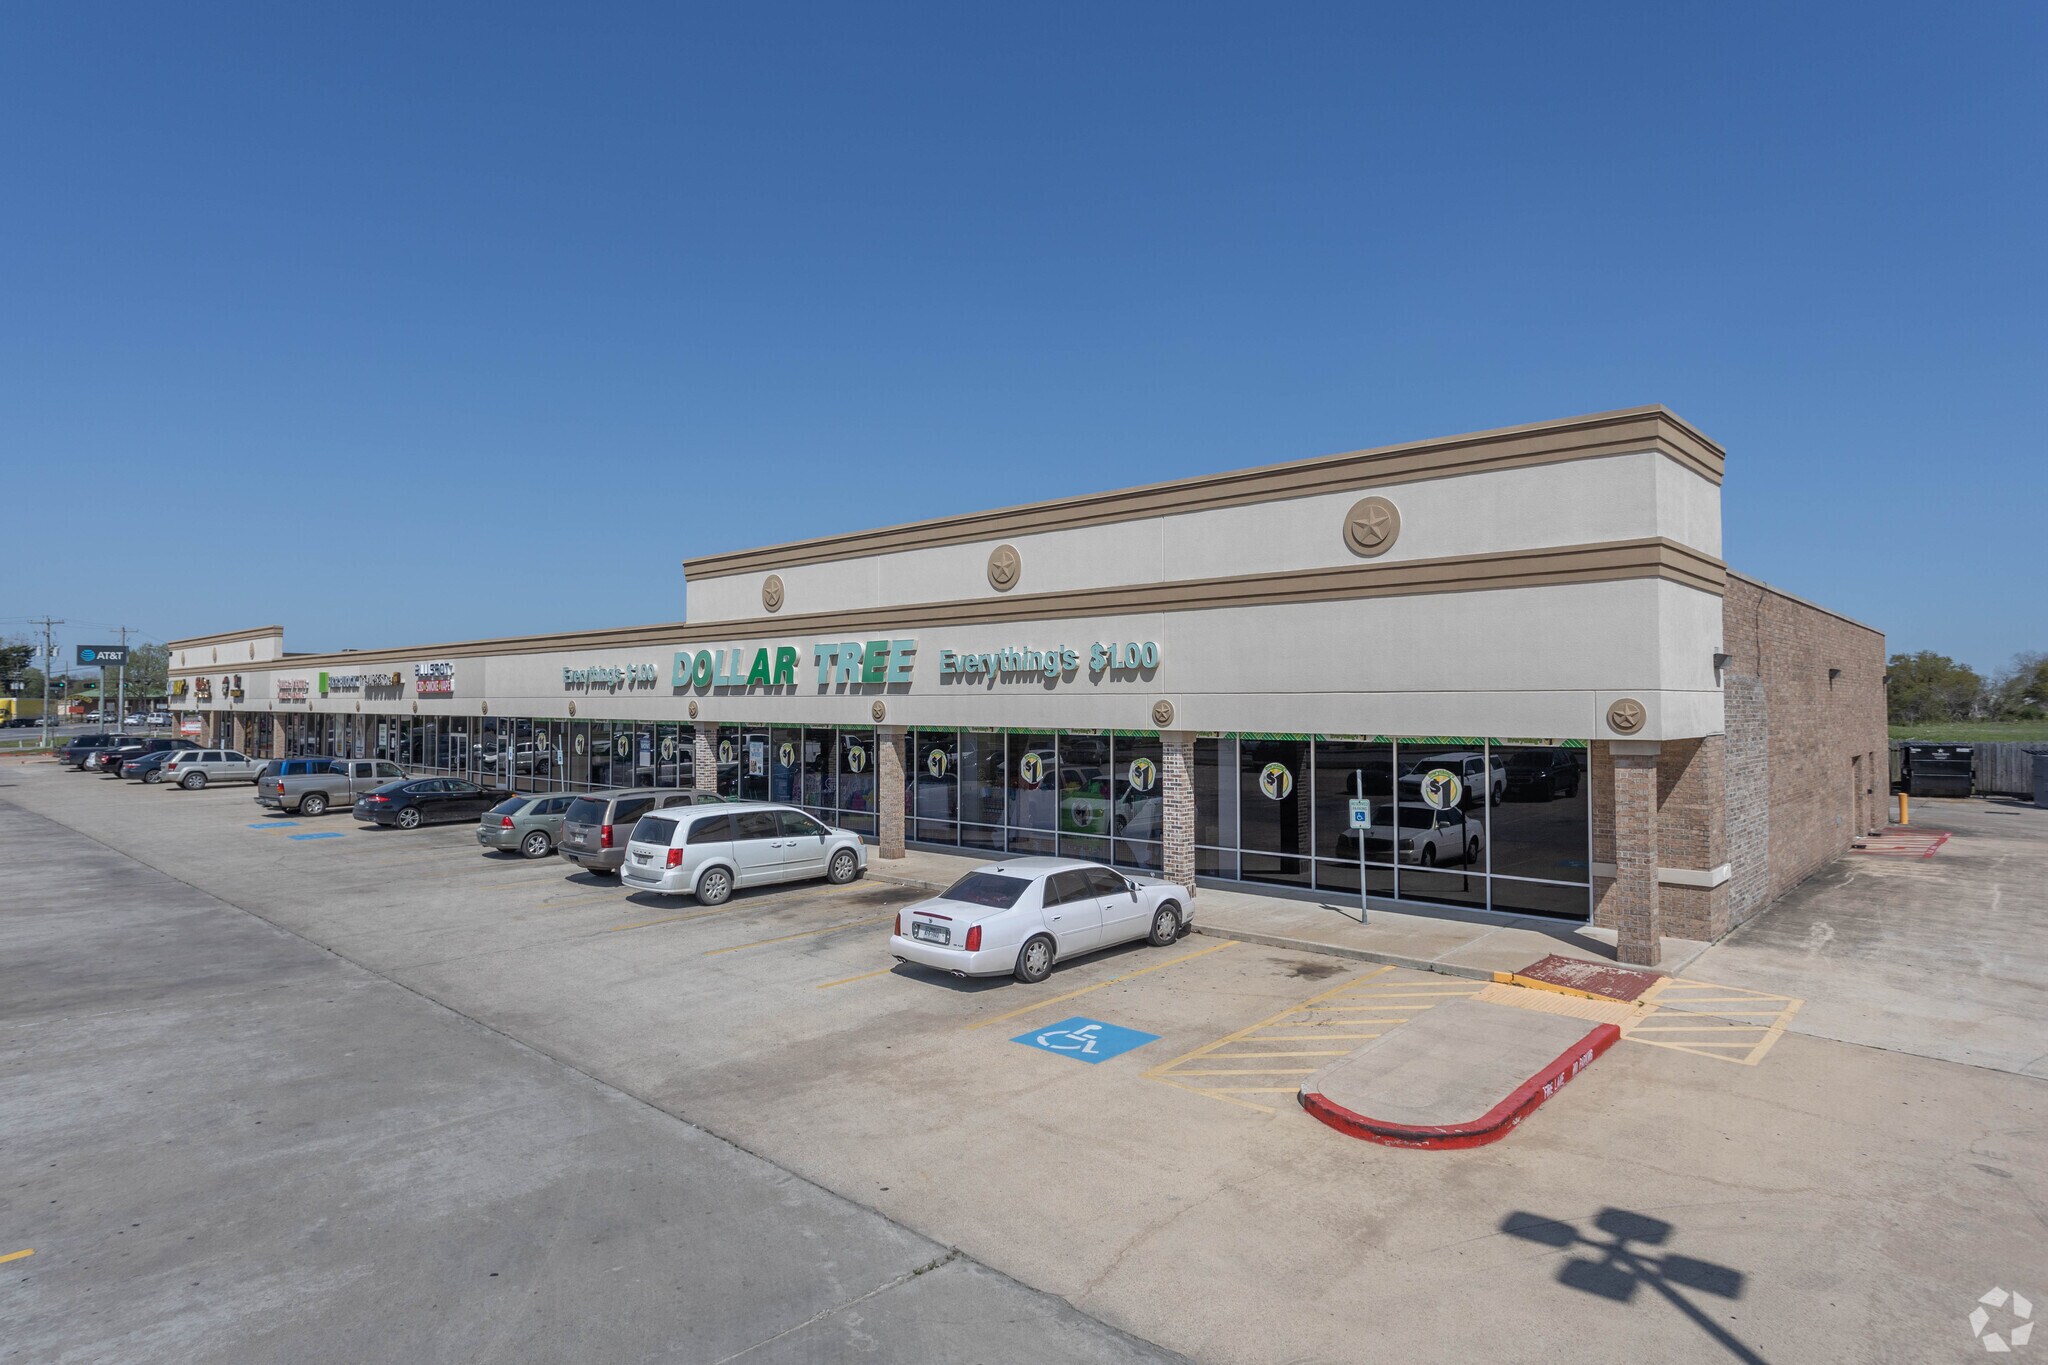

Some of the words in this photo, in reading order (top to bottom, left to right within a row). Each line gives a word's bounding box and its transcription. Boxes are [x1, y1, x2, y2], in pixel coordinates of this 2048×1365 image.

[96, 651, 124, 660] AT&T
[672, 646, 799, 687] DOLLAR
[813, 639, 917, 683] TREE
[940, 644, 1080, 678] Everything's
[1089, 641, 1160, 673] $1.00
[562, 665, 625, 687] Everything's
[626, 663, 657, 683] $1.00
[1025, 758, 1038, 783] $1
[1132, 765, 1150, 791] $1
[1265, 770, 1284, 799] $1
[1429, 778, 1451, 809] $1
